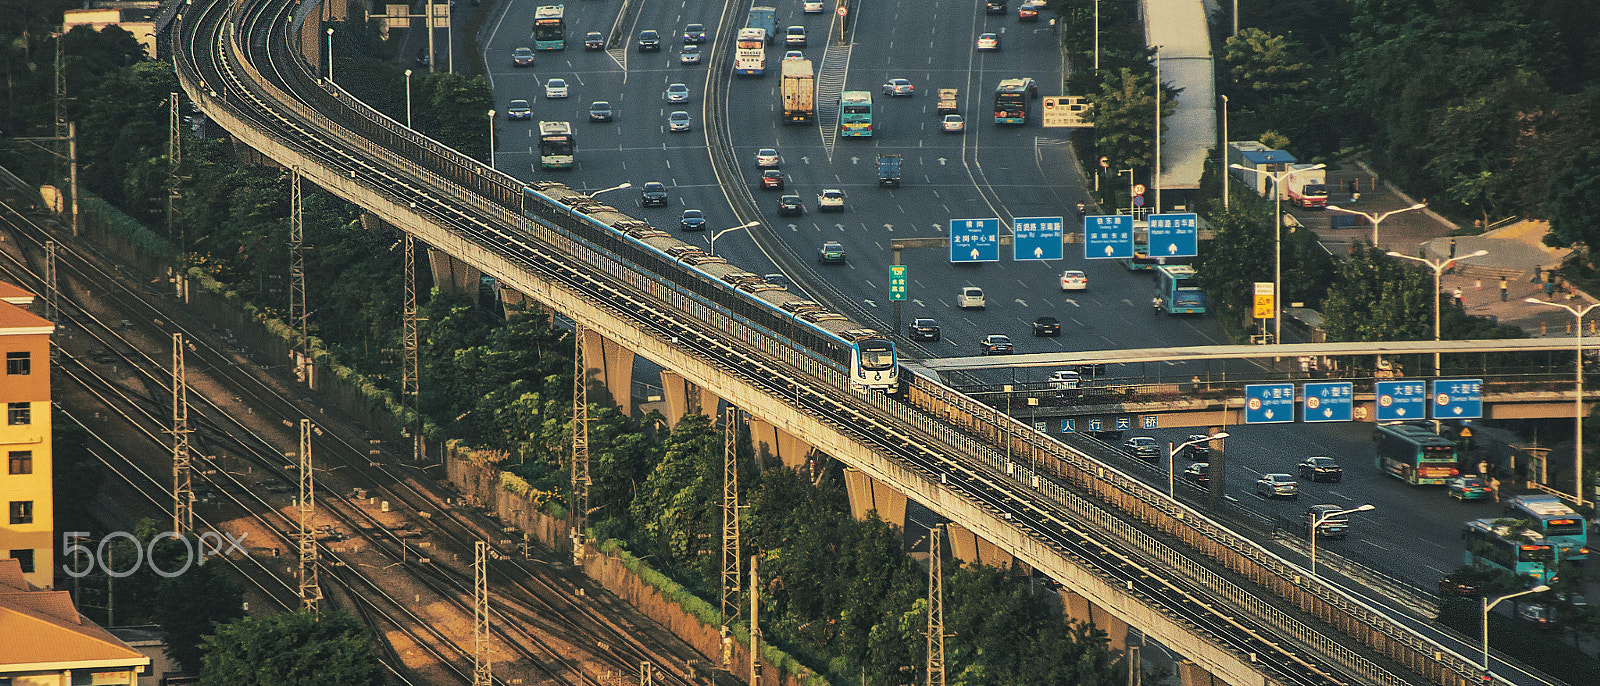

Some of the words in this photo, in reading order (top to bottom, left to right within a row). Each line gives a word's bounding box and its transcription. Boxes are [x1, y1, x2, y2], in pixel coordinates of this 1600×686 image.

[1263, 388, 1292, 398] 小型车
[1321, 386, 1350, 397] 小型车
[1394, 385, 1423, 395] 大型车
[1451, 383, 1480, 394] 大型车
